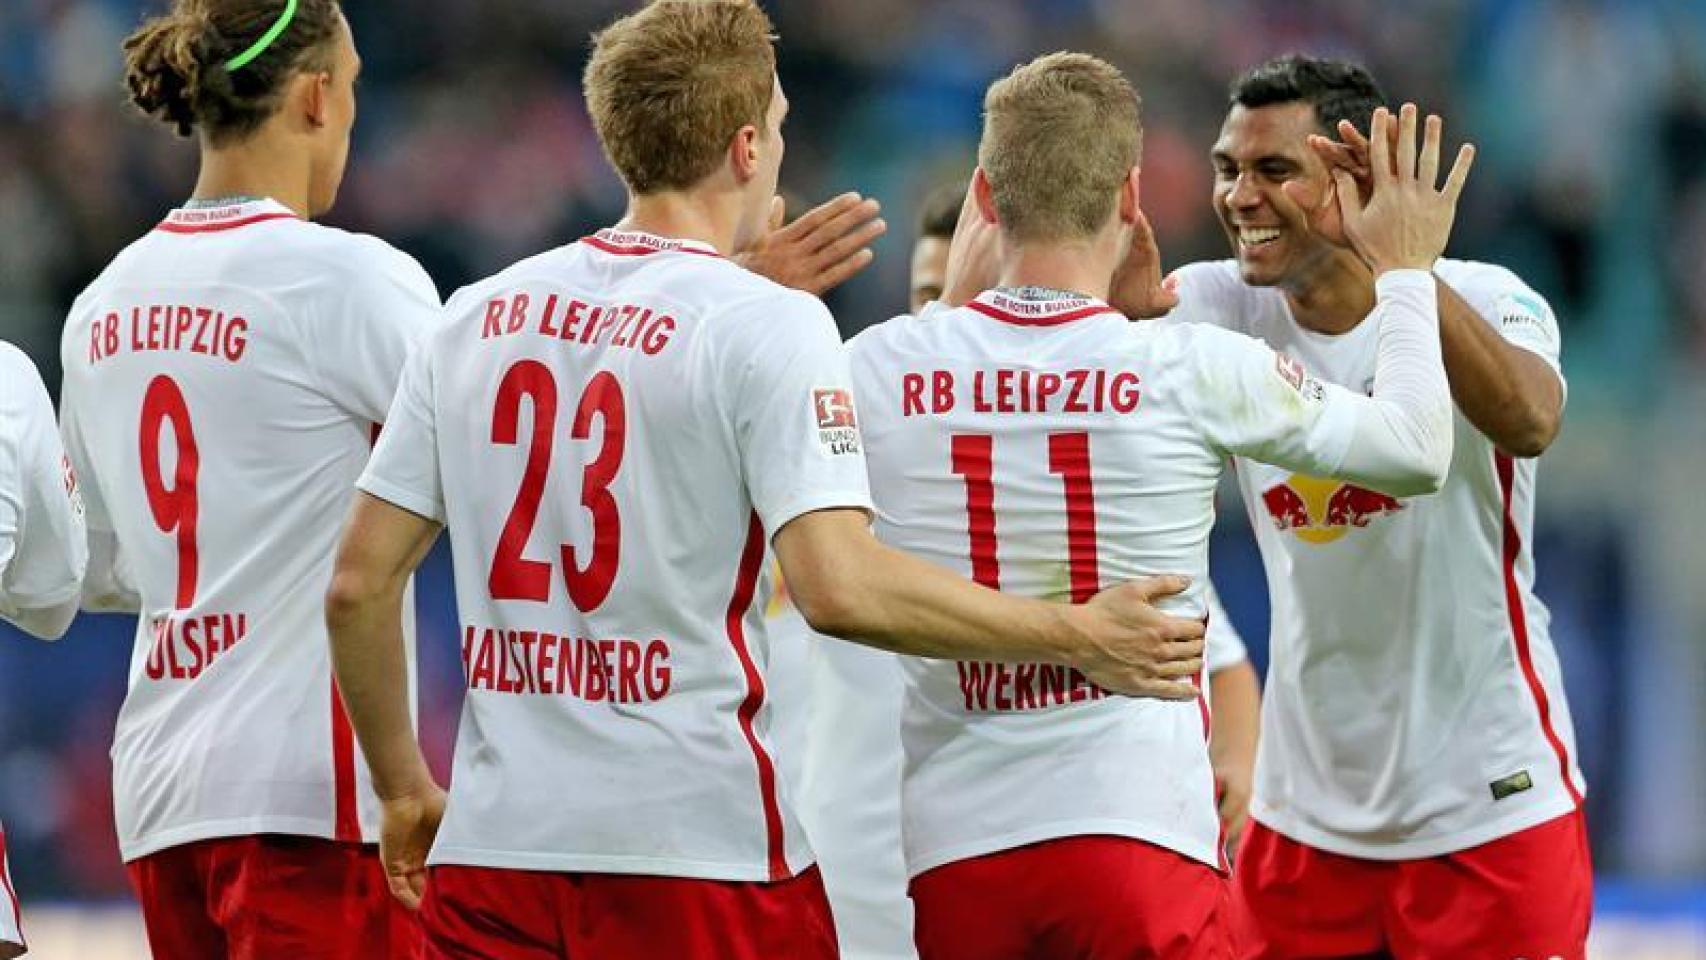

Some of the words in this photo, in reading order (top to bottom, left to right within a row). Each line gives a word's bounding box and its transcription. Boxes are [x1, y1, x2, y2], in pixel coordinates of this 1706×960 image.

[90, 312, 119, 364] RB
[132, 304, 248, 362] LEIPZIG
[482, 293, 529, 339] RB
[538, 294, 676, 355] LEIPZIG
[903, 371, 955, 416] RB
[974, 370, 1141, 414] LEIPZIG
[139, 374, 199, 611] 9
[488, 359, 626, 613] 23
[951, 432, 1100, 604] 11
[463, 625, 671, 703] HALSTENBERG
